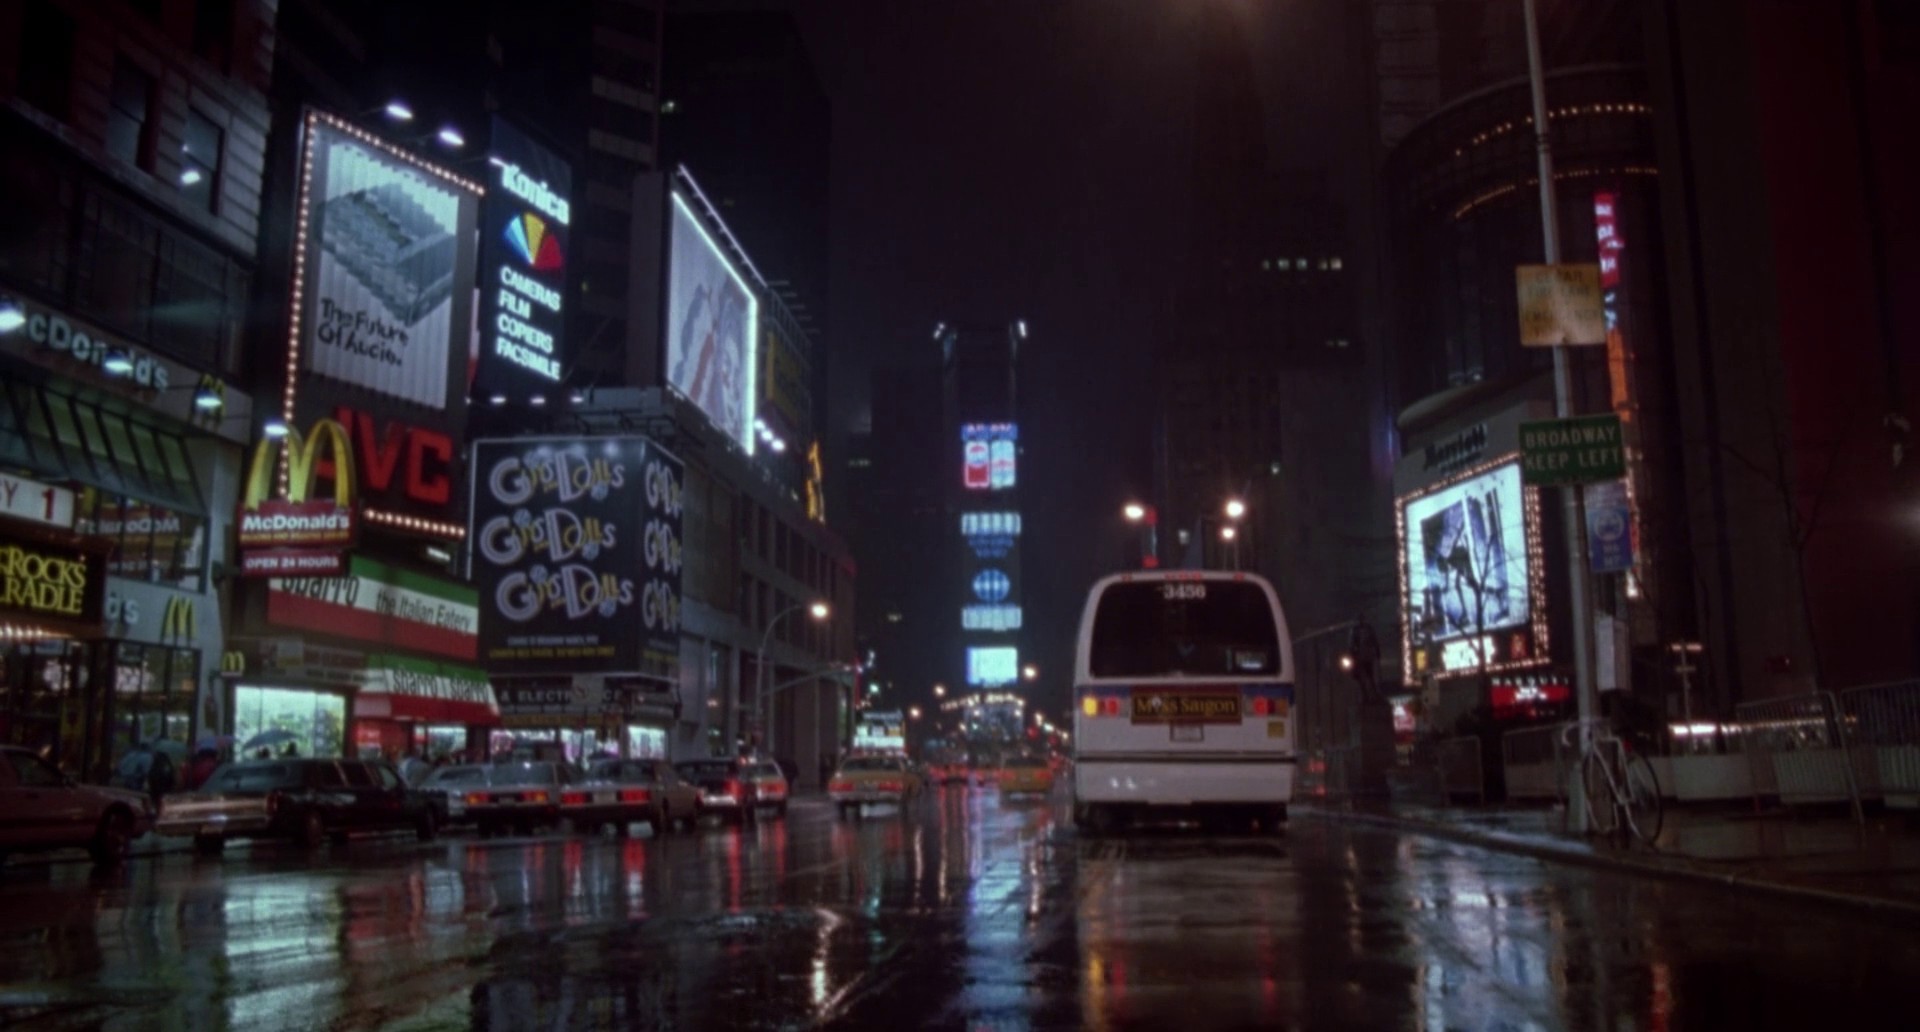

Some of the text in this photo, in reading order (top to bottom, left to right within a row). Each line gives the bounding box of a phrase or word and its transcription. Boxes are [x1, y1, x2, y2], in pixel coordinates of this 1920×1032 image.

[502, 164, 570, 225] Konica
[500, 266, 561, 311] CAMERAS
[500, 289, 531, 319] FILM
[498, 313, 554, 354] COPIERS
[496, 336, 561, 380] FACSIMILE
[1525, 425, 1615, 449] BROADWAY
[1525, 447, 1619, 472] KEEP LEFT
[243, 513, 350, 531] McDonald's
[0, 546, 87, 589] ROCKS
[246, 556, 339, 569] OPEN 24 HOURS
[0, 576, 84, 615] RADLE
[376, 590, 397, 616] the
[399, 594, 435, 623] Italian
[435, 604, 472, 635] Eatery
[1181, 697, 1236, 717] Saigon
